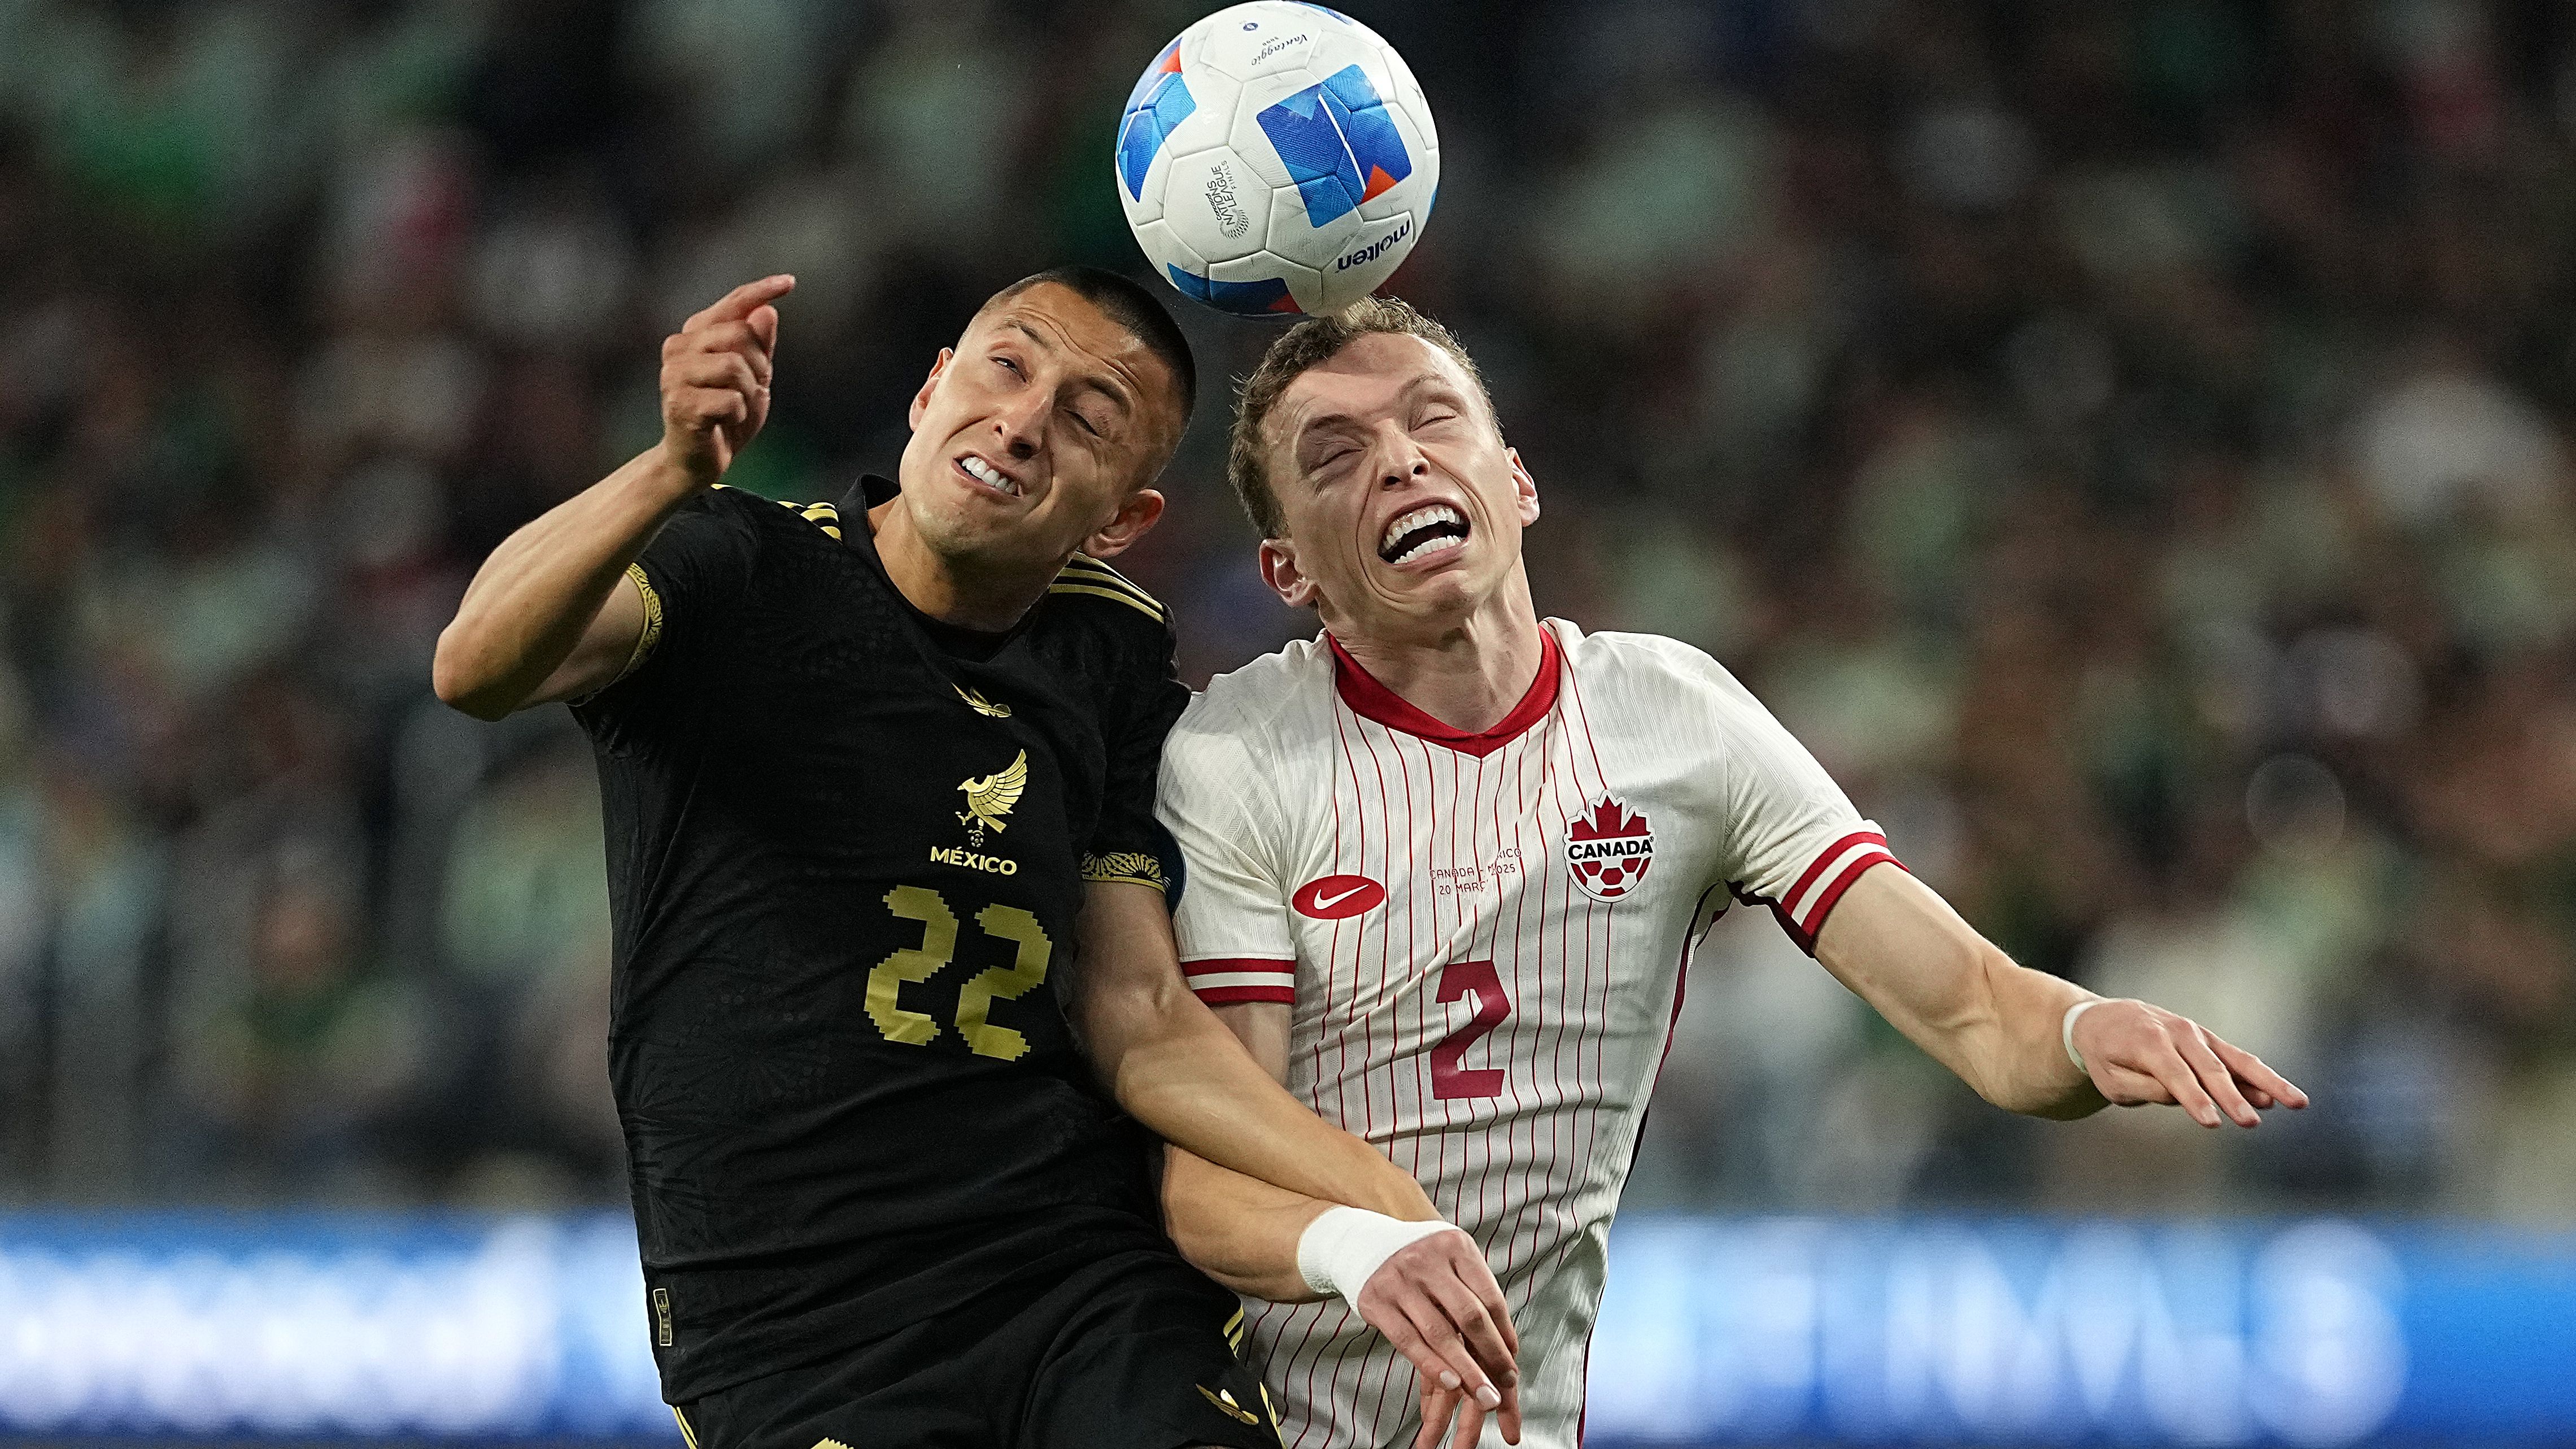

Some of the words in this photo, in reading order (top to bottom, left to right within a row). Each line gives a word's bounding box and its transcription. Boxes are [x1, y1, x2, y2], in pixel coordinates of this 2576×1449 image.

[1251, 34, 1307, 66] Vantaggio
[1211, 165, 1237, 208] LEAGUE
[1221, 160, 1237, 190] FINALS
[1207, 180, 1235, 225] NATIONS
[1337, 219, 1410, 270] molten
[930, 846, 1017, 875] MÉXICO
[1568, 839, 1653, 860] CANADA
[1429, 867, 1475, 880] CANADA
[1439, 885, 1451, 895] 20
[864, 884, 1052, 1062] 22
[1430, 959, 1512, 1100] 2
